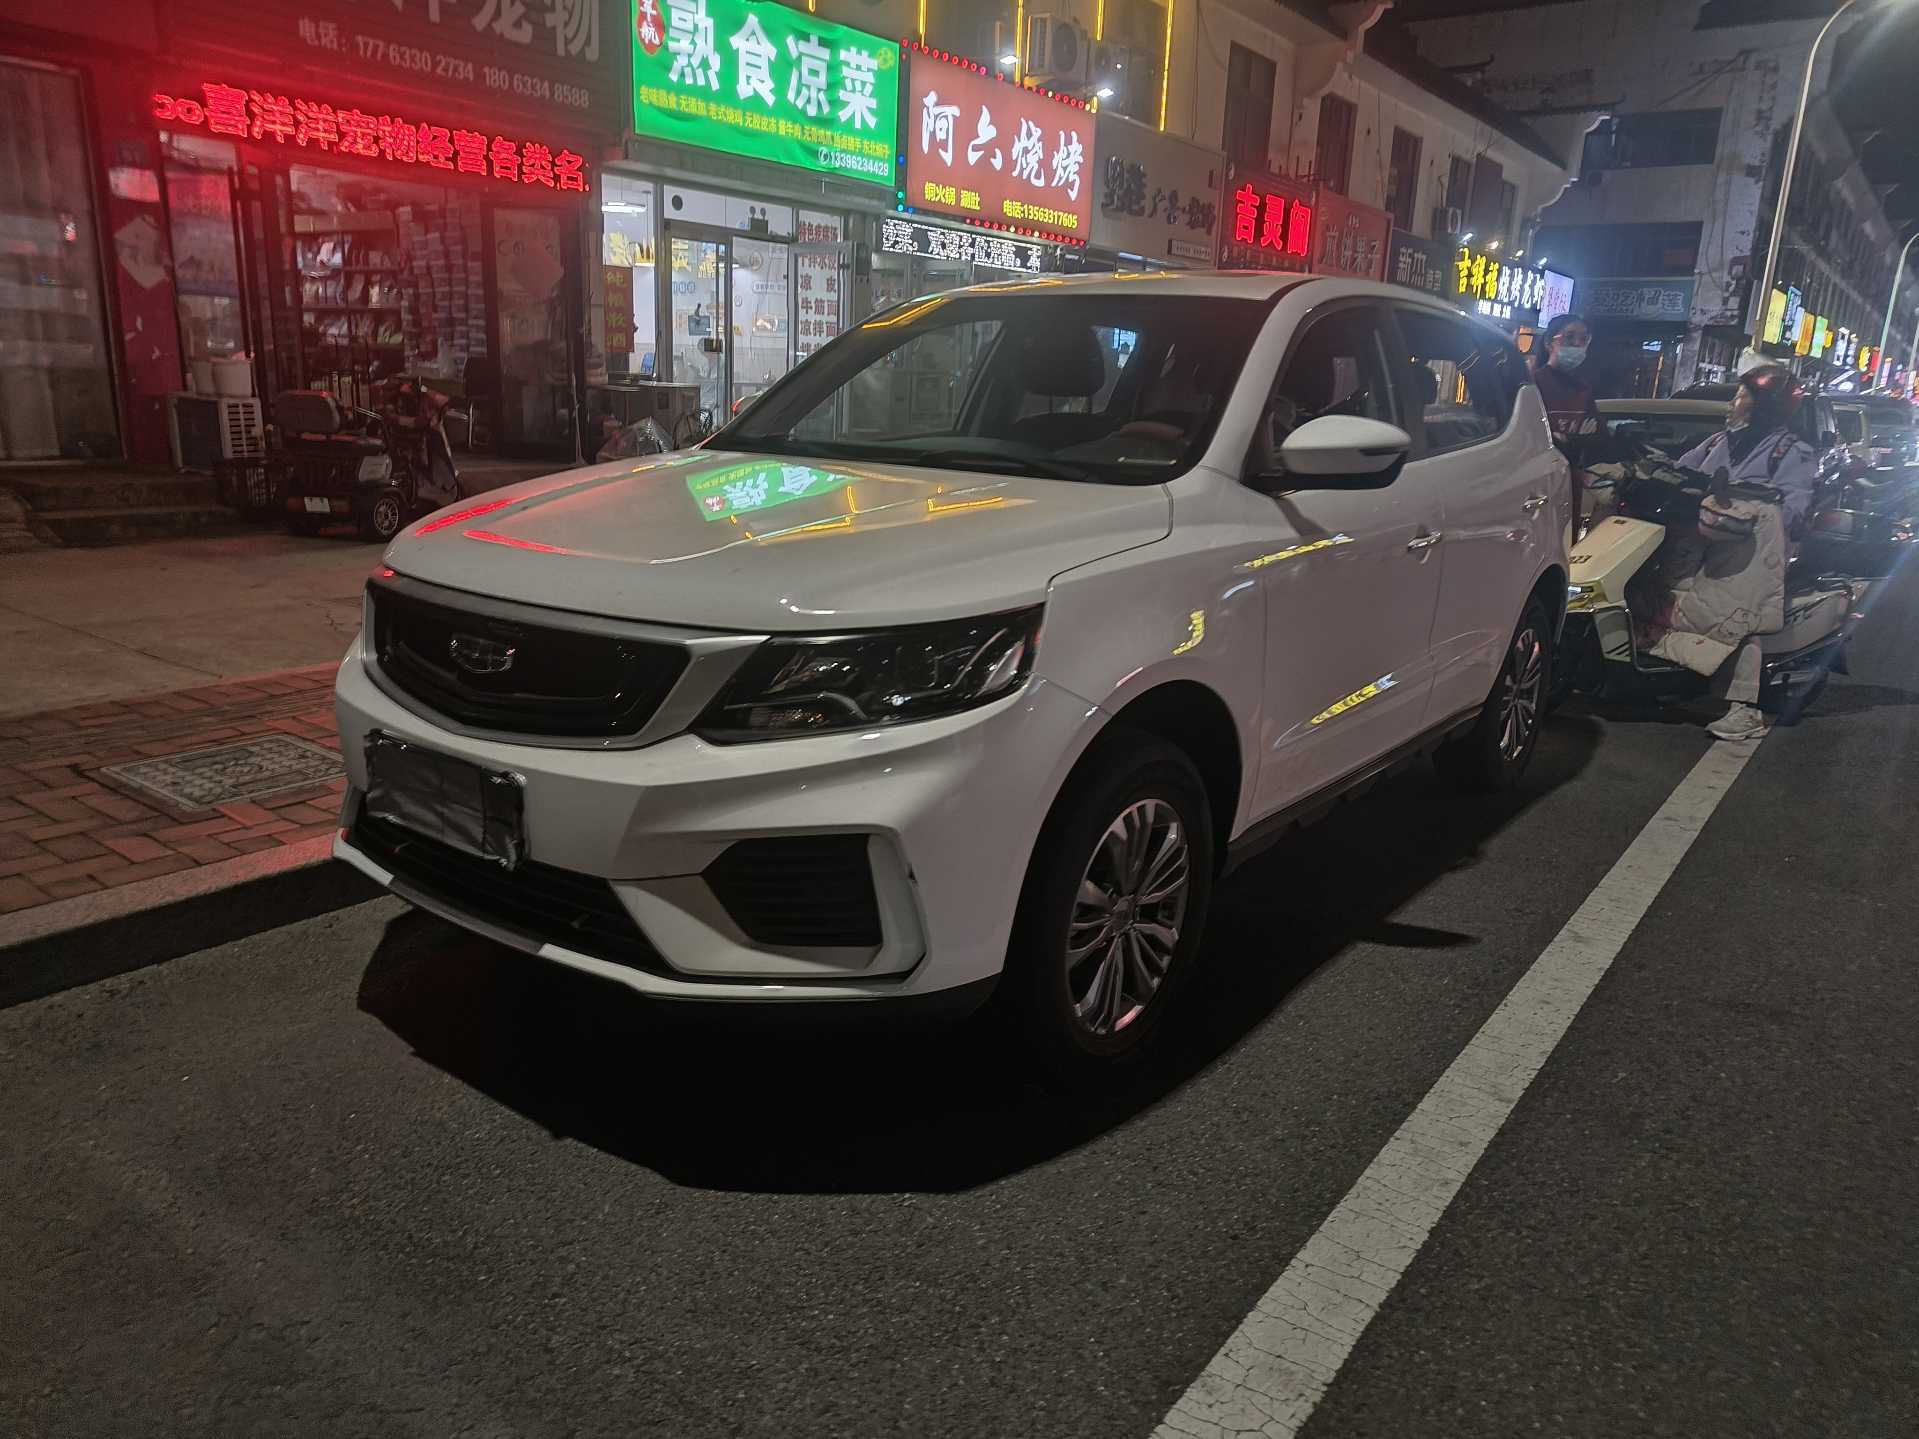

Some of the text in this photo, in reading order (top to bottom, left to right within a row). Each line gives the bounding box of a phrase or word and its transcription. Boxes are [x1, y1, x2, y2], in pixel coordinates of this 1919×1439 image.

[668, 0, 878, 129] 熟食凉菜
[921, 90, 1083, 201] 阿六烧烤
[829, 151, 889, 176] 13396234429
[924, 181, 956, 206] 铜火锅
[801, 297, 838, 315] 牛筋面
[800, 318, 838, 337] 凉拌面
